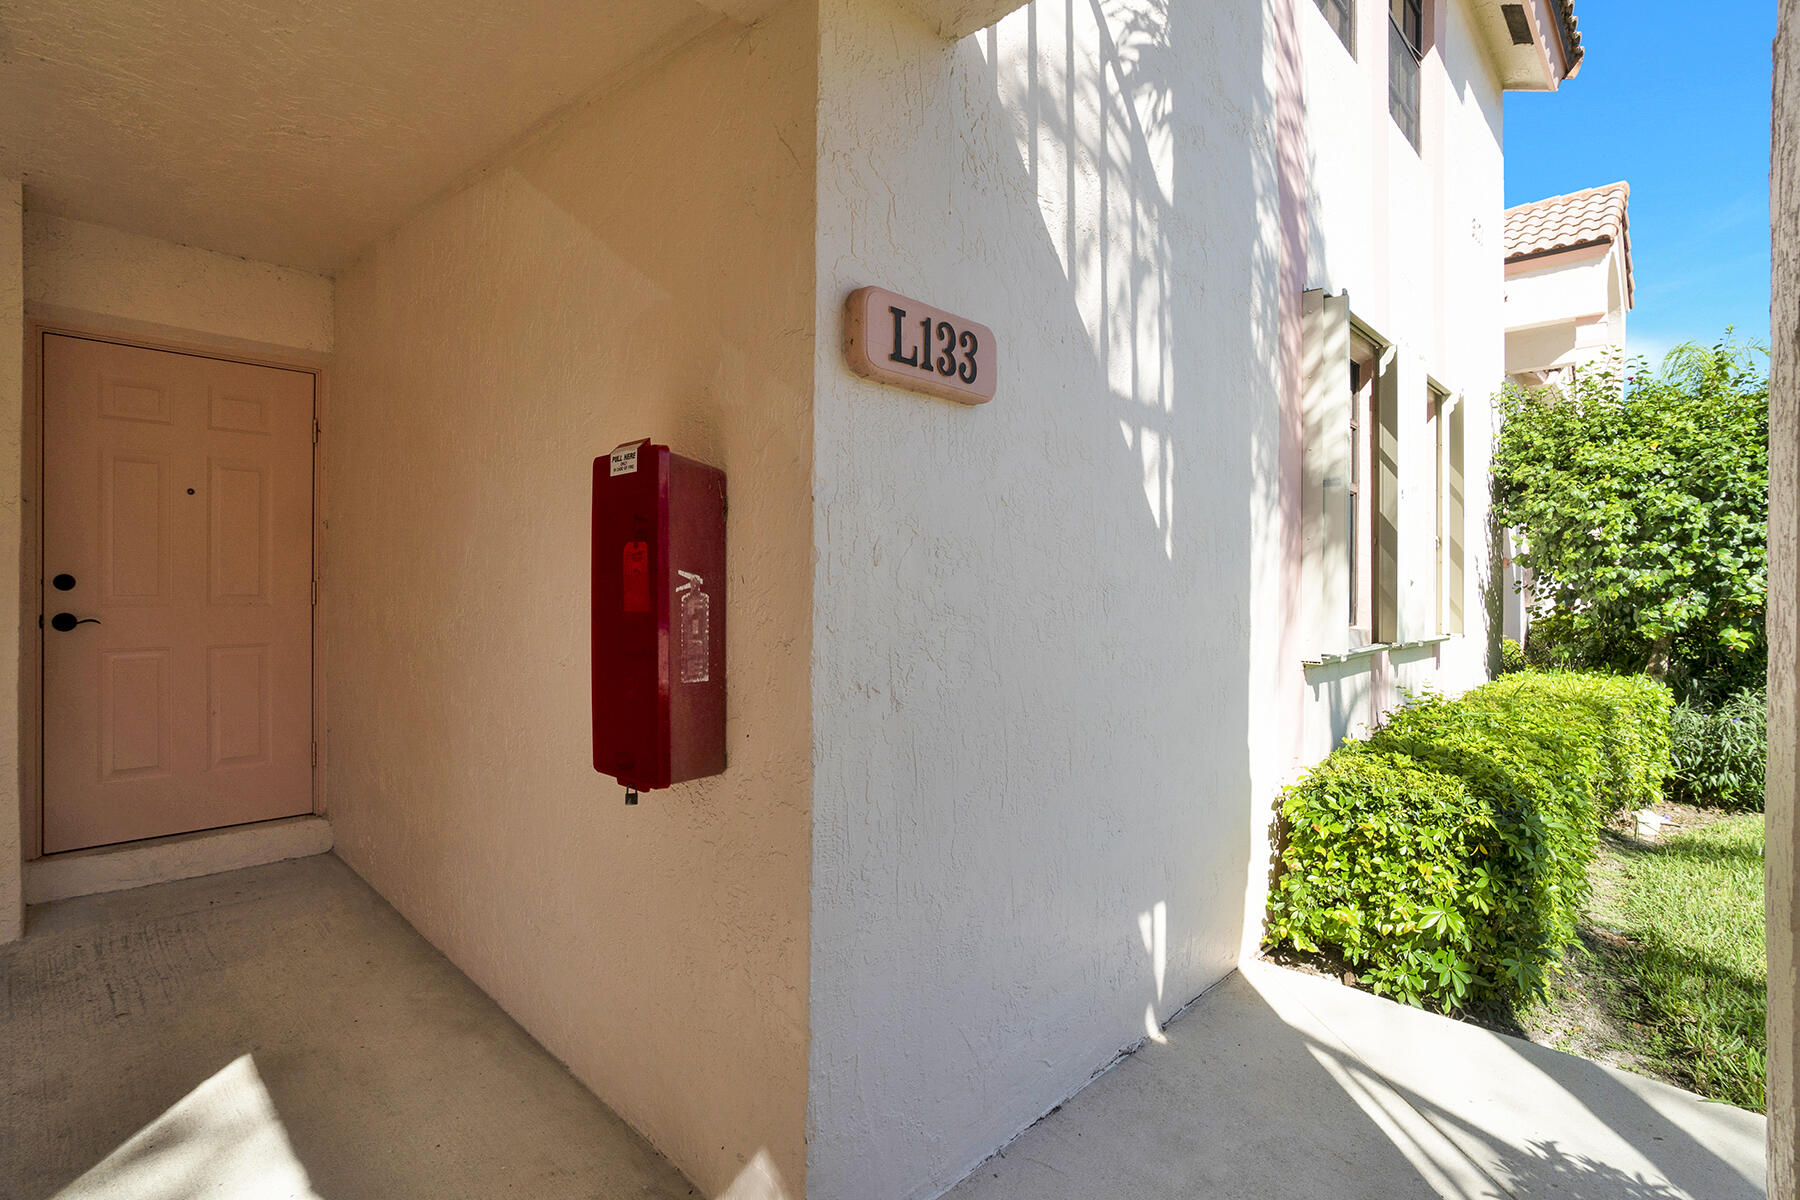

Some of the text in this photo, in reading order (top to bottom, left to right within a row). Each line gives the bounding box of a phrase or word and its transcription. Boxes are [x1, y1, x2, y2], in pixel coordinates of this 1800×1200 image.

[888, 305, 978, 385] L133
[612, 452, 636, 463] PULL HERE
